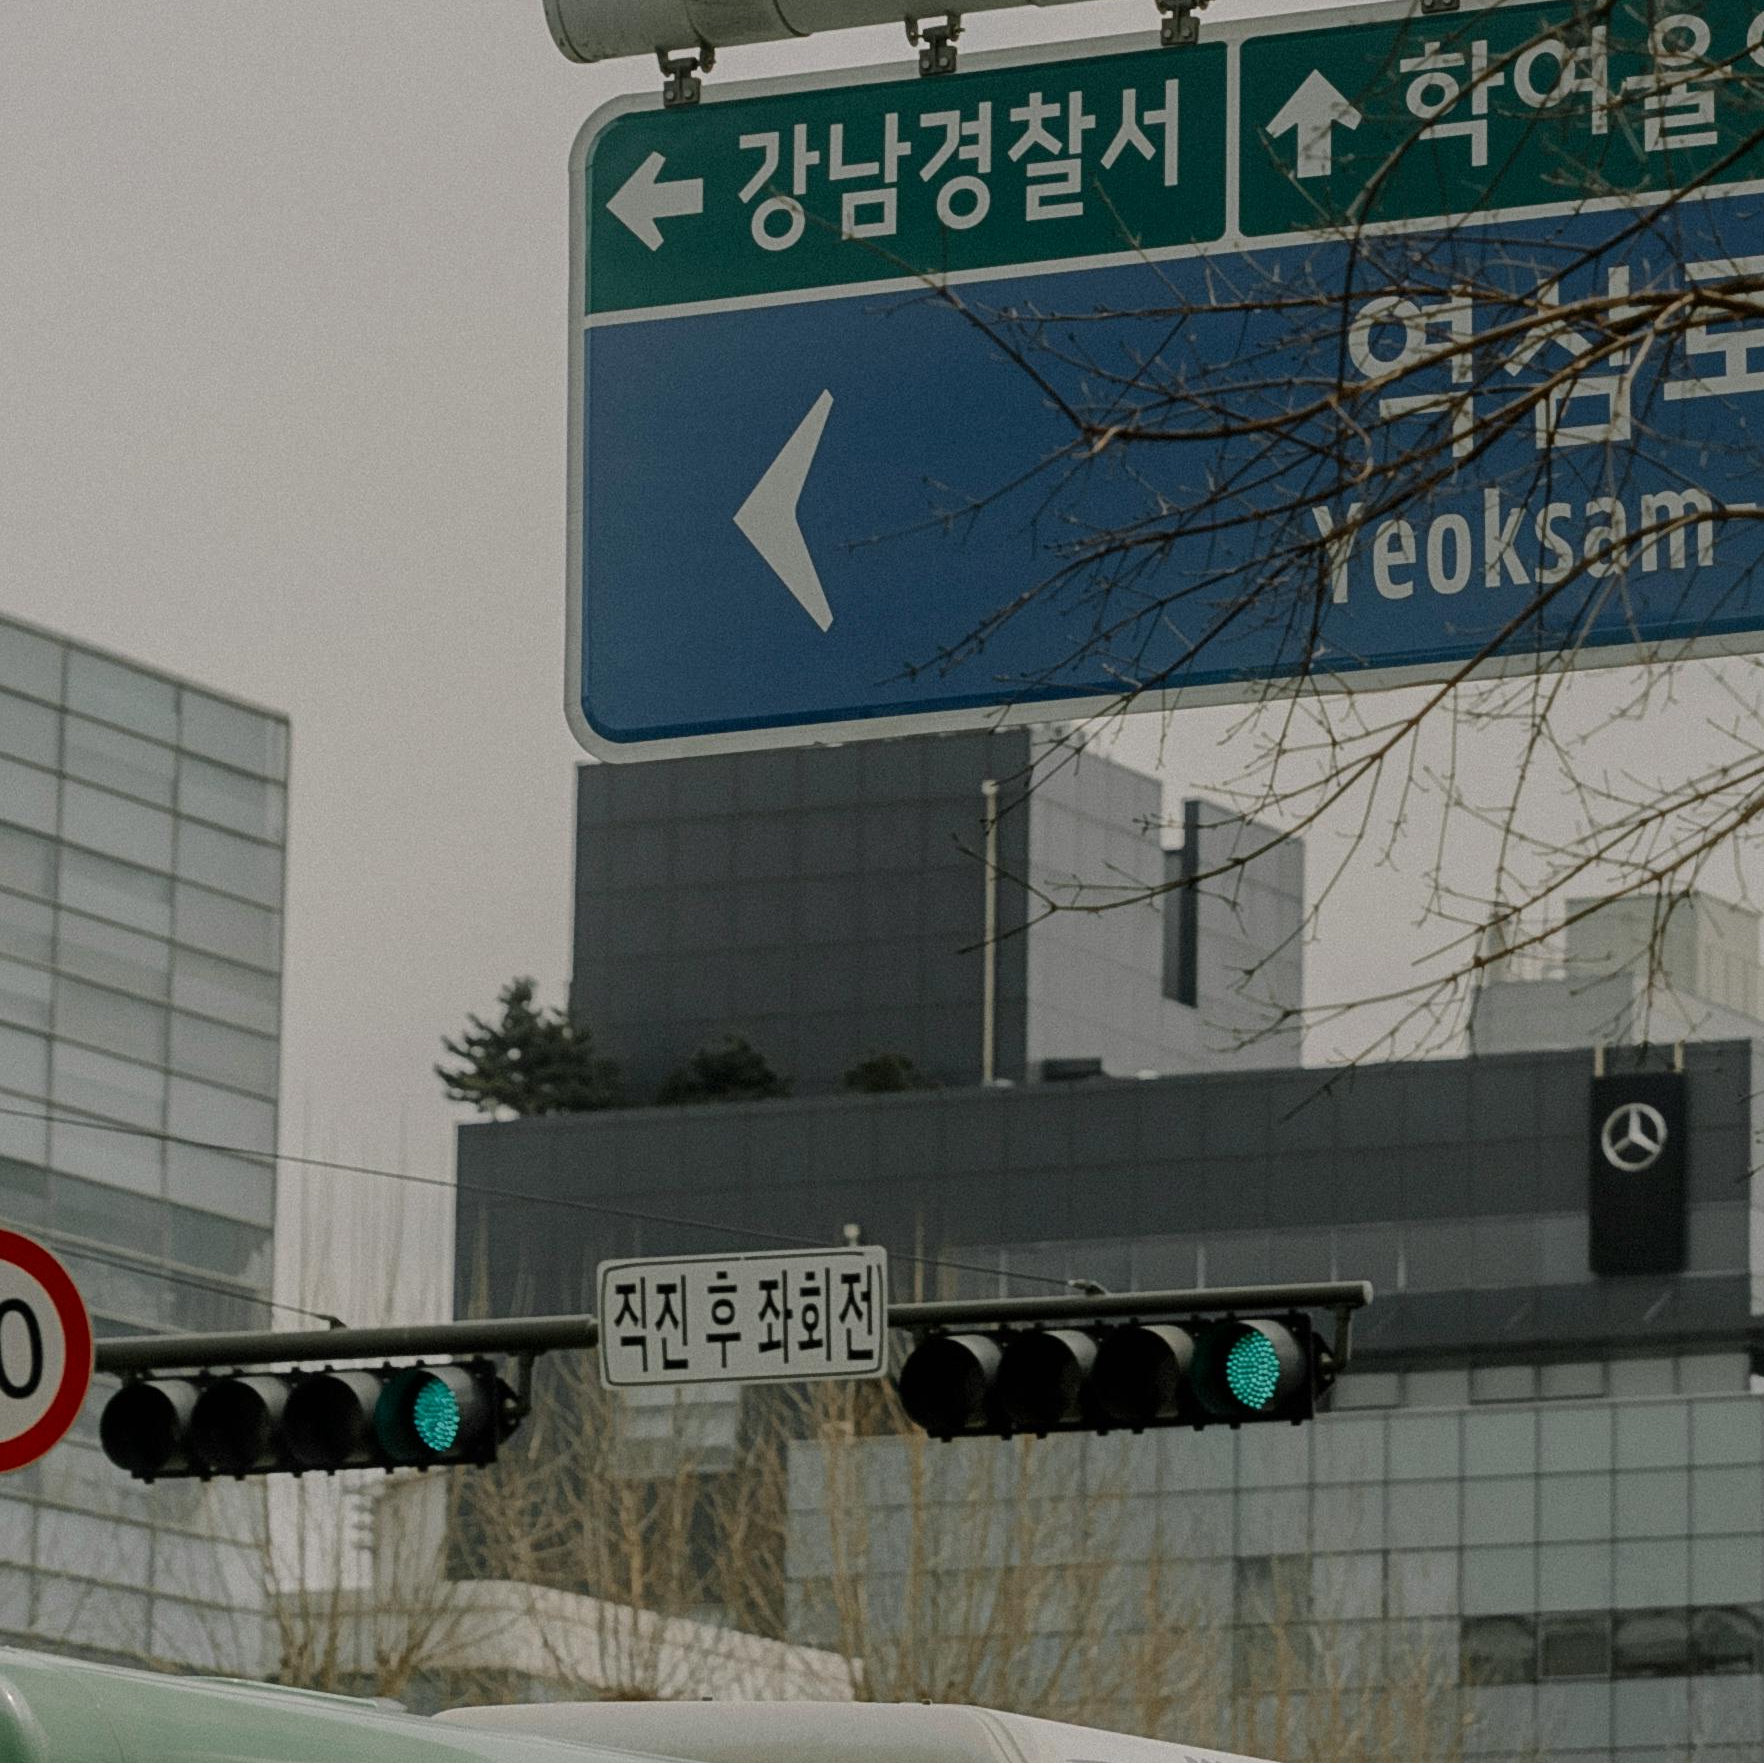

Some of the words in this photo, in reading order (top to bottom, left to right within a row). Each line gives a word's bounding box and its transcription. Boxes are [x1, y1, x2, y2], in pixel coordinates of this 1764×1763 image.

[737, 78, 1181, 253] 강남경찰서
[613, 1273, 689, 1373] 직진
[705, 1270, 742, 1369] 후
[757, 1264, 875, 1364] 좌회전
